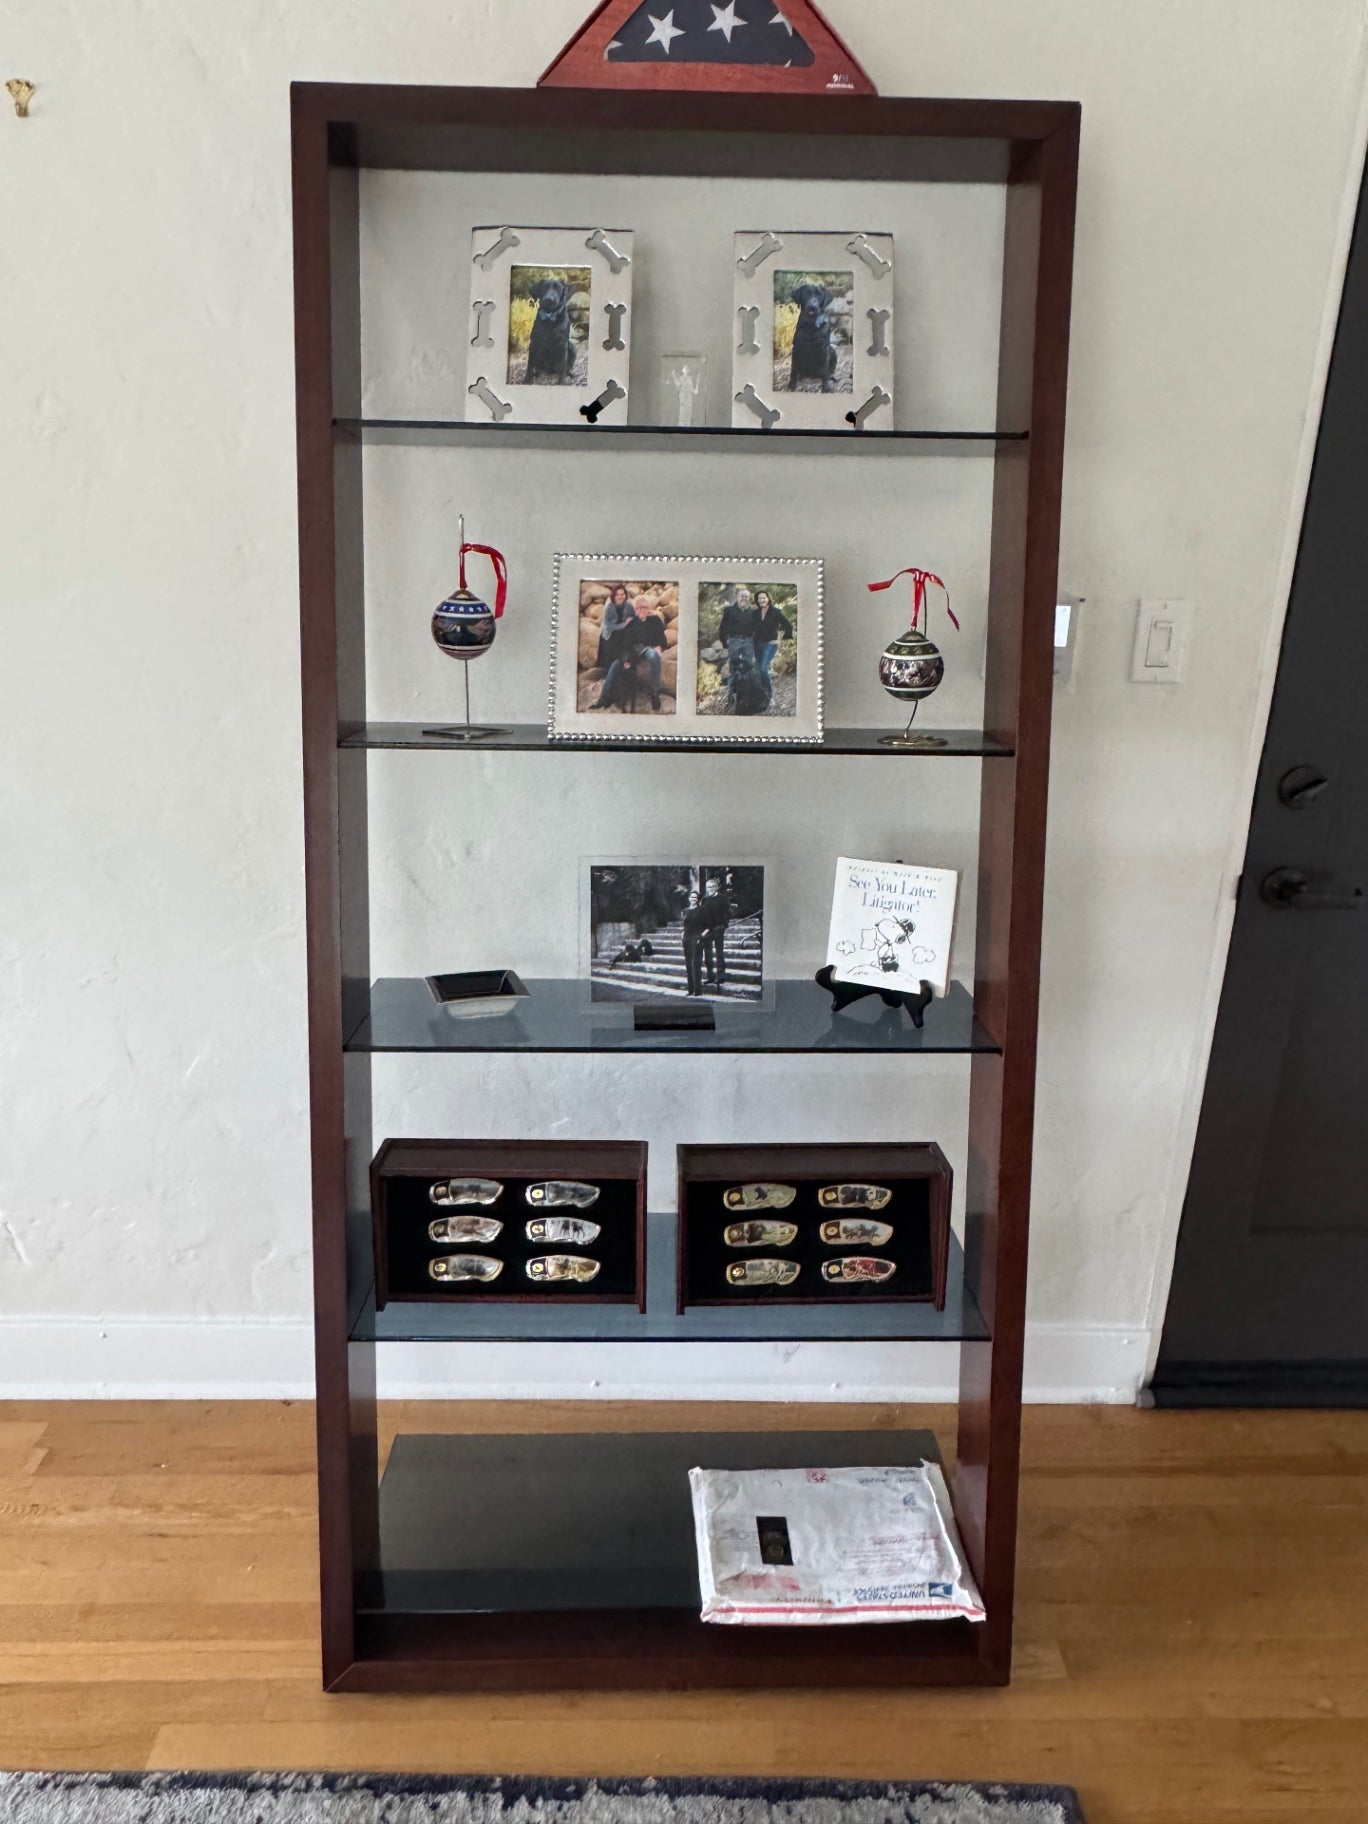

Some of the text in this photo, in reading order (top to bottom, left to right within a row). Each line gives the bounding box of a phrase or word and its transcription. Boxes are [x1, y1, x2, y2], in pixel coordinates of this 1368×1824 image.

[848, 874, 871, 889] See
[875, 877, 897, 893] You
[862, 892, 920, 914] Litigator!
[889, 1589, 926, 1600] UNITED
